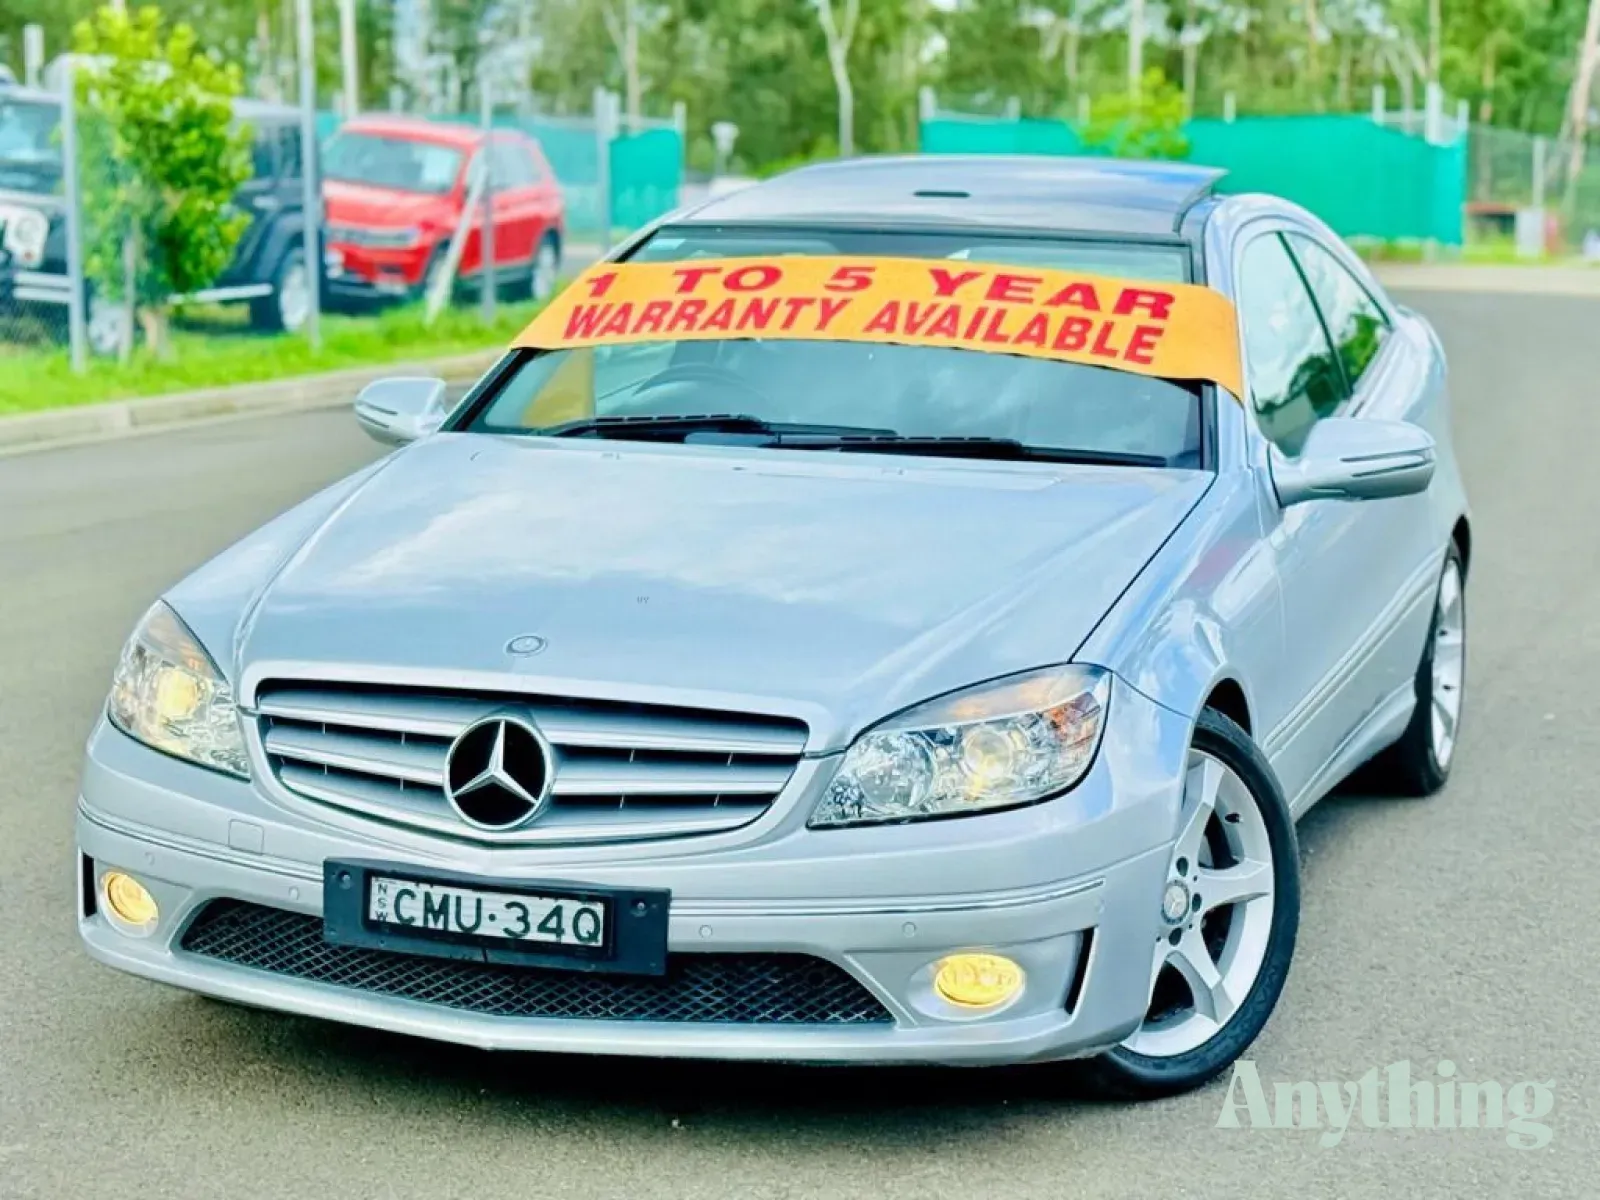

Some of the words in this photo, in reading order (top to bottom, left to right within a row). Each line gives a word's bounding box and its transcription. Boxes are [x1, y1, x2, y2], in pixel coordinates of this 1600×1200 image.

[586, 272, 617, 297] 1
[673, 266, 782, 293] TO
[825, 266, 874, 291] 5
[930, 268, 1176, 322] YEAR
[563, 297, 850, 340] WARRANTY
[865, 301, 1167, 365] AVAILABLE
